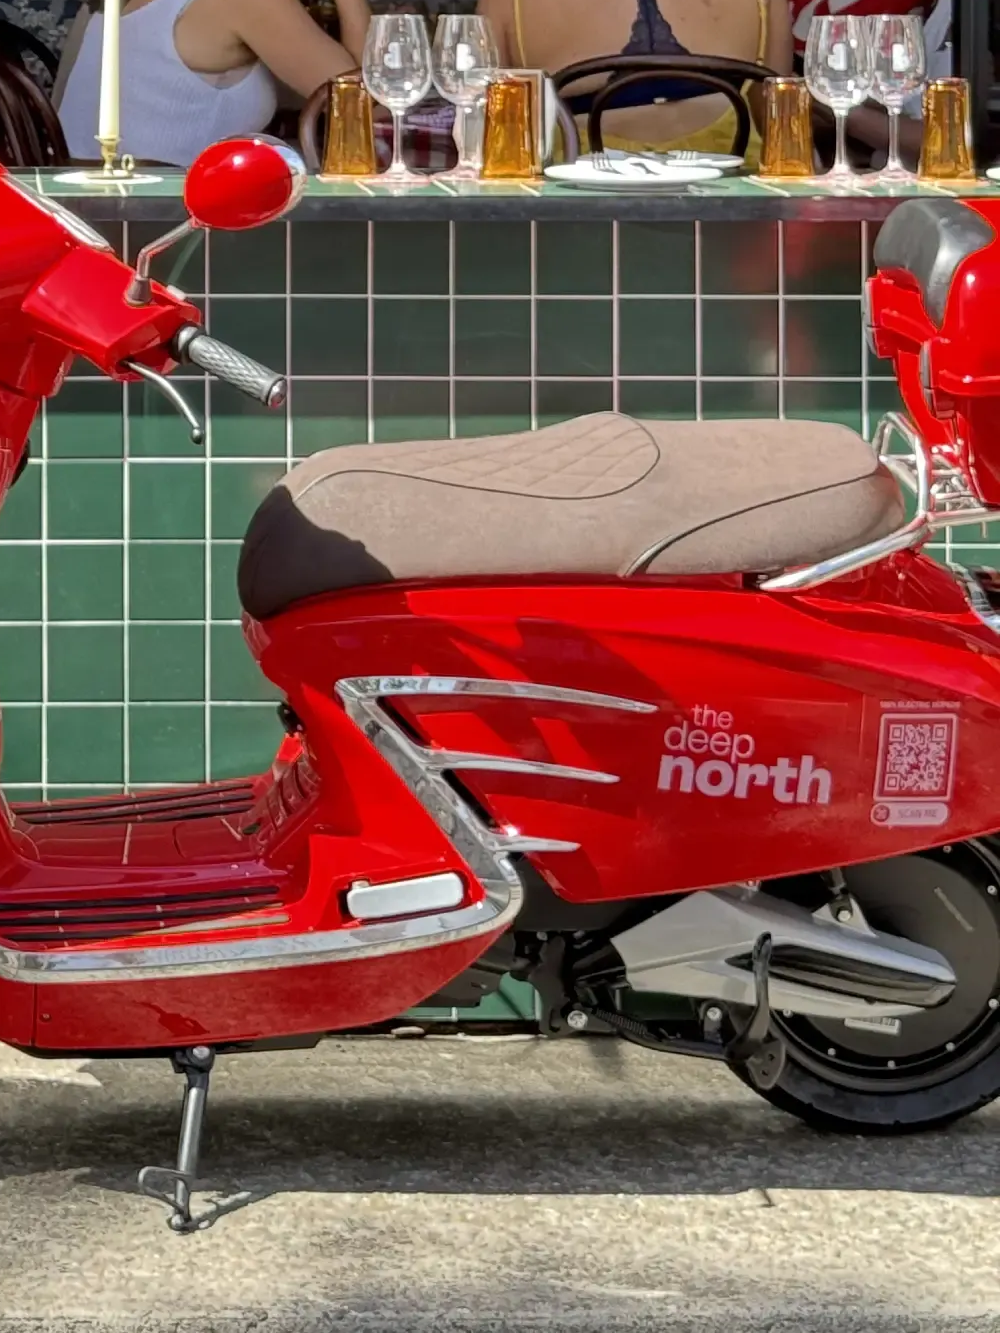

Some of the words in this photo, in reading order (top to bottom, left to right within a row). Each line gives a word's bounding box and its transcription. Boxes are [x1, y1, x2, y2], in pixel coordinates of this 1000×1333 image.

[692, 704, 734, 729] the
[664, 721, 755, 763] deep
[657, 754, 832, 806] north
[898, 807, 921, 819] SCAN
[924, 808, 939, 819] ME
